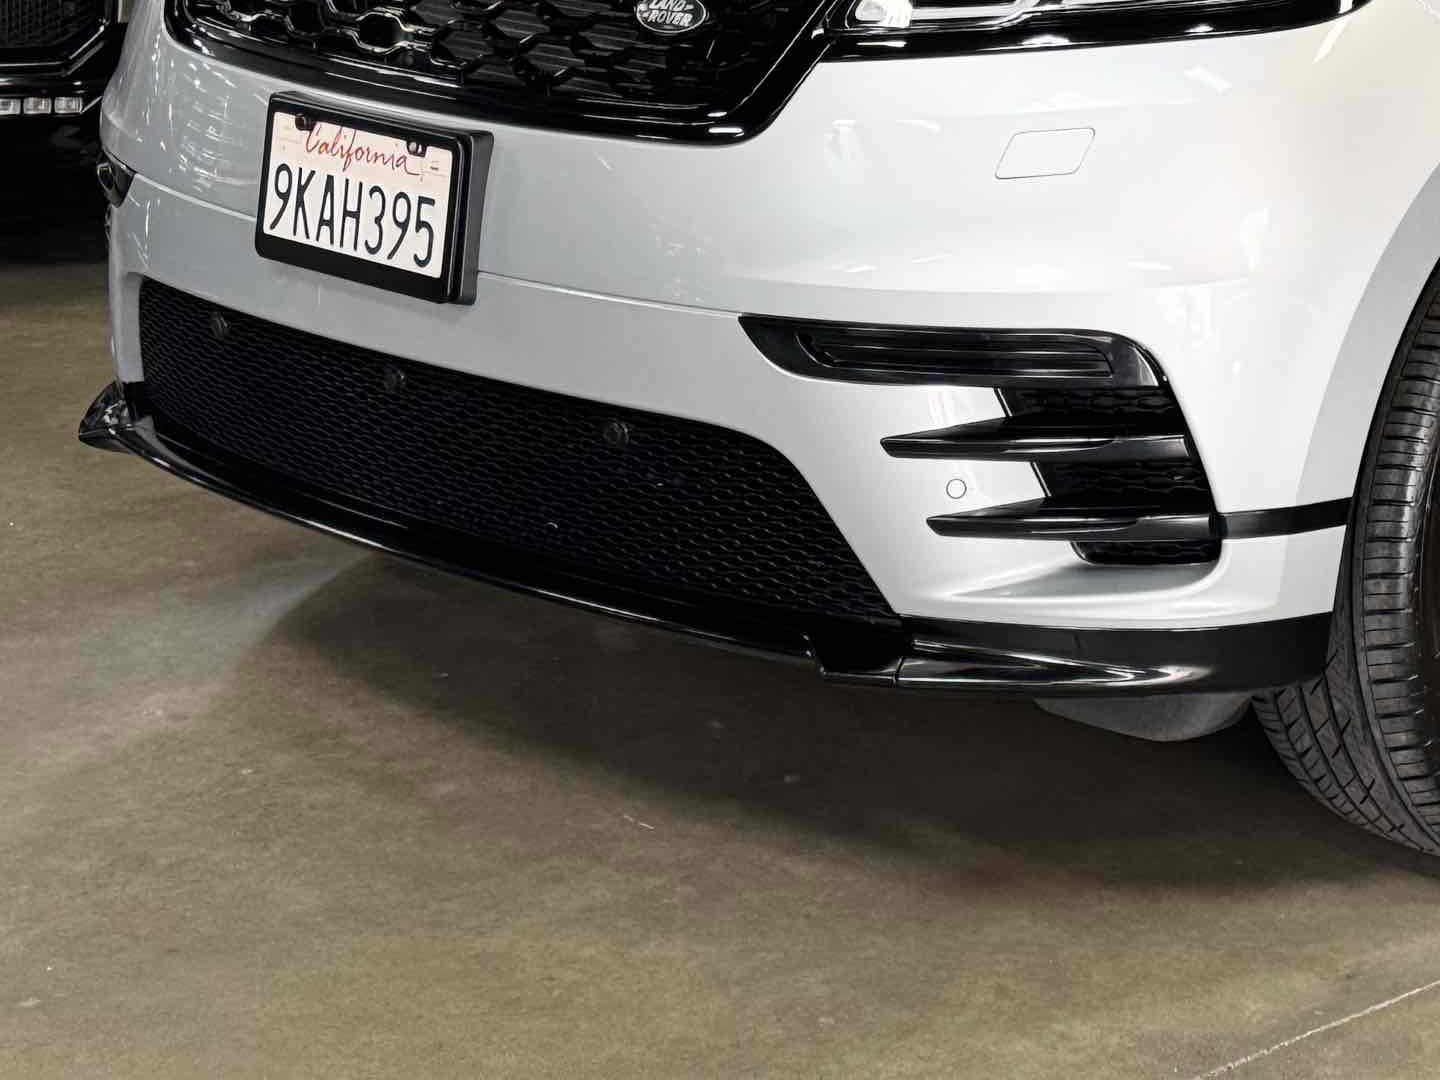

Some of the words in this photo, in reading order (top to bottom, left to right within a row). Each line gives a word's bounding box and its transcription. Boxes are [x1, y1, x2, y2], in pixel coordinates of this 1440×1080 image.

[647, 9, 693, 27] ROVER
[305, 124, 420, 175] California
[270, 163, 436, 268] 9KAH395
